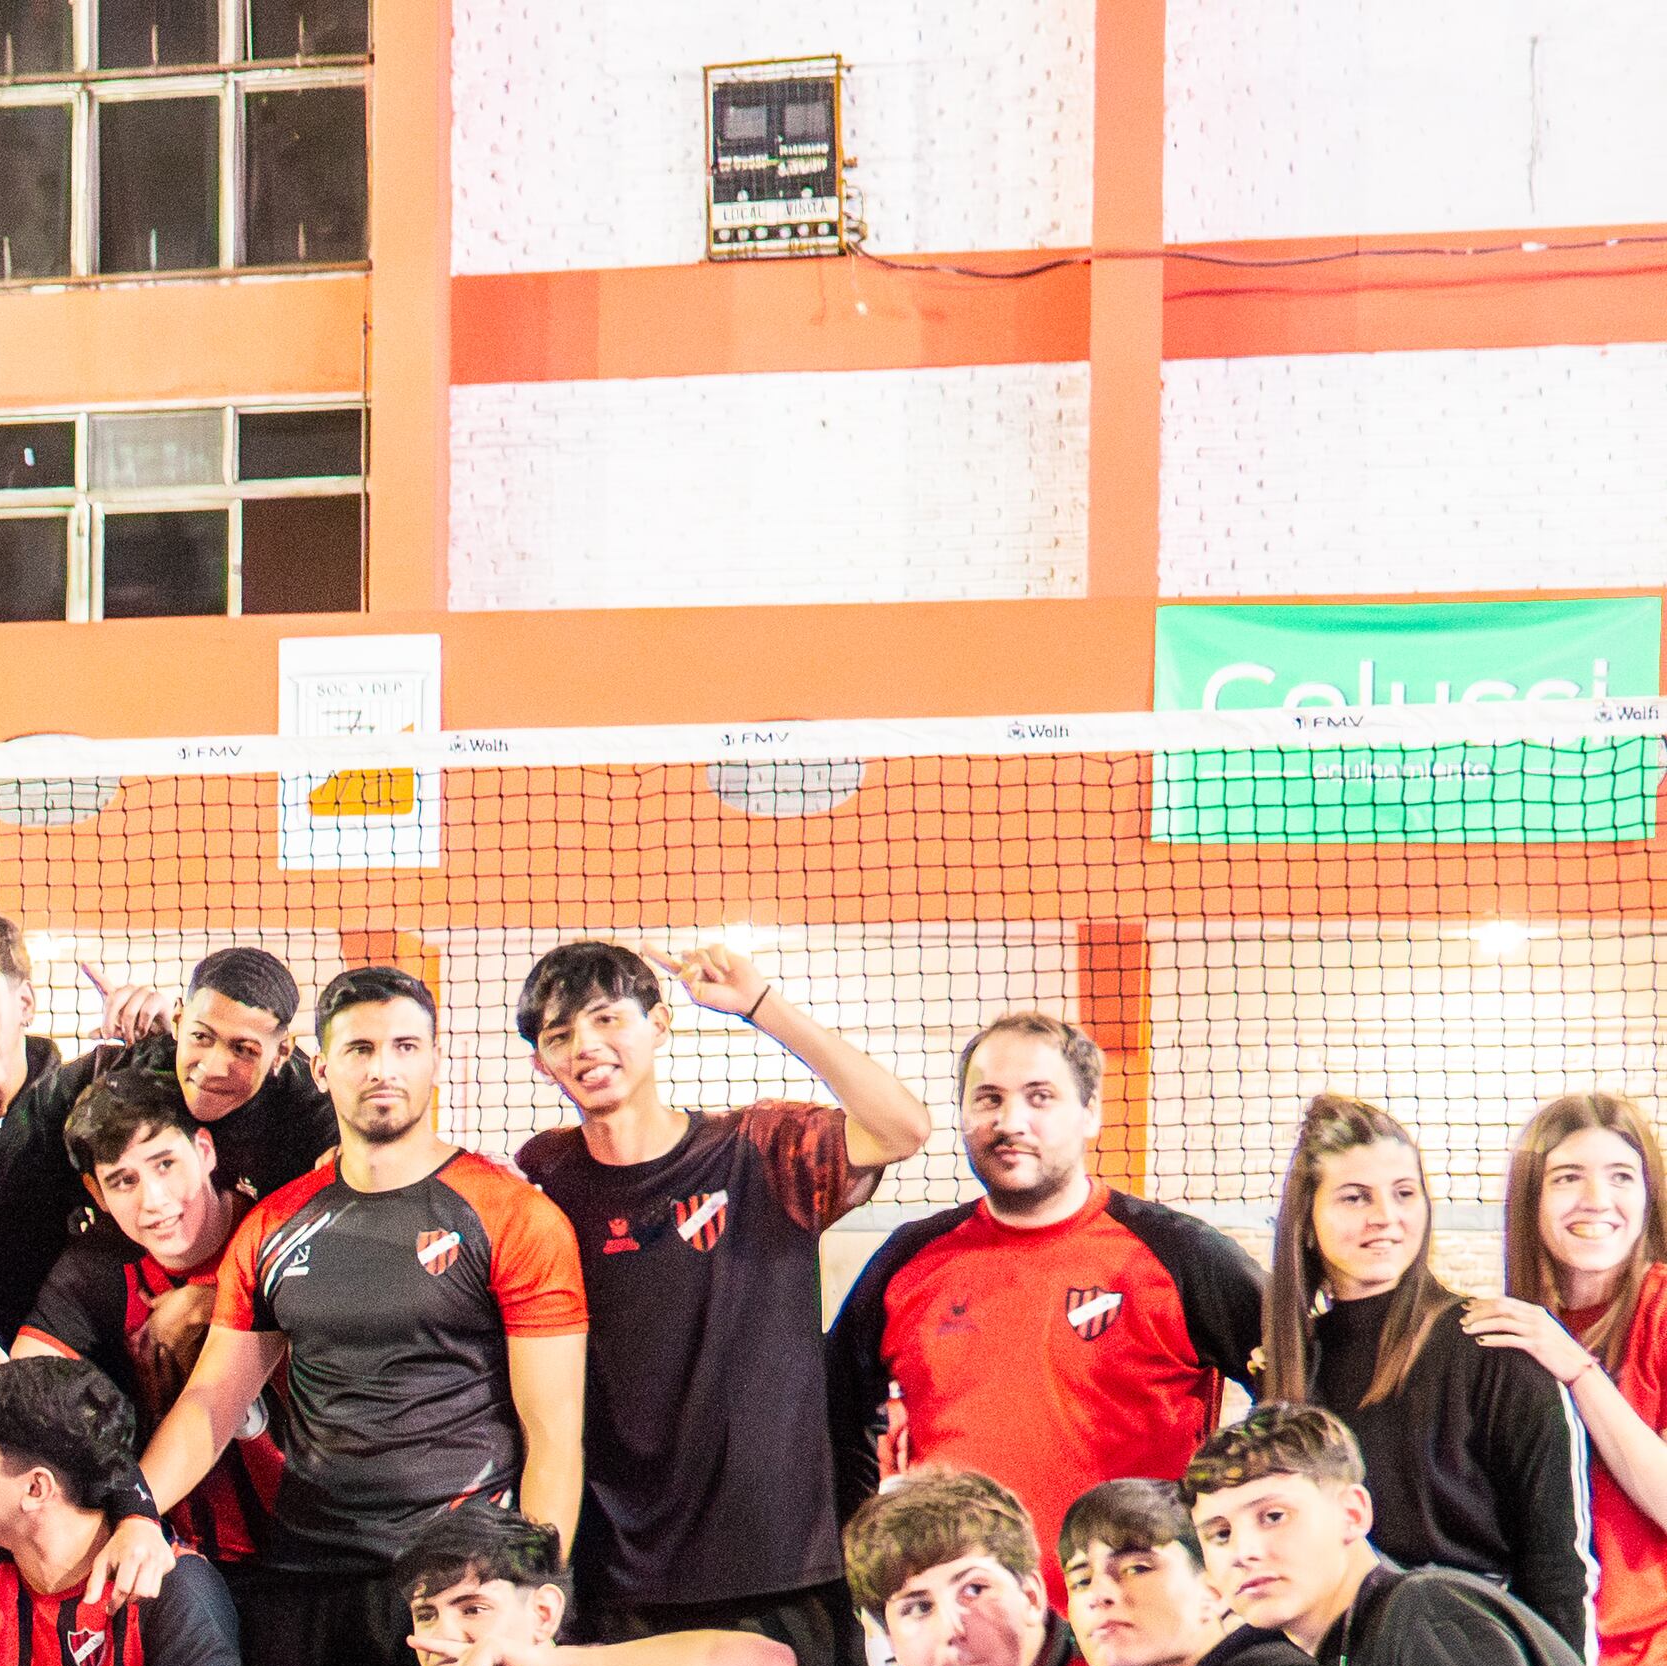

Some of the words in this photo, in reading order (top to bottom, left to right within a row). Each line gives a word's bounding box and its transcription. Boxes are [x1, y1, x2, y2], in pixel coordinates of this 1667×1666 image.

[1313, 715, 1364, 728] FMV
[742, 732, 789, 744] FMV
[197, 746, 242, 758] FMV
[1312, 759, 1492, 786] equipamiento
